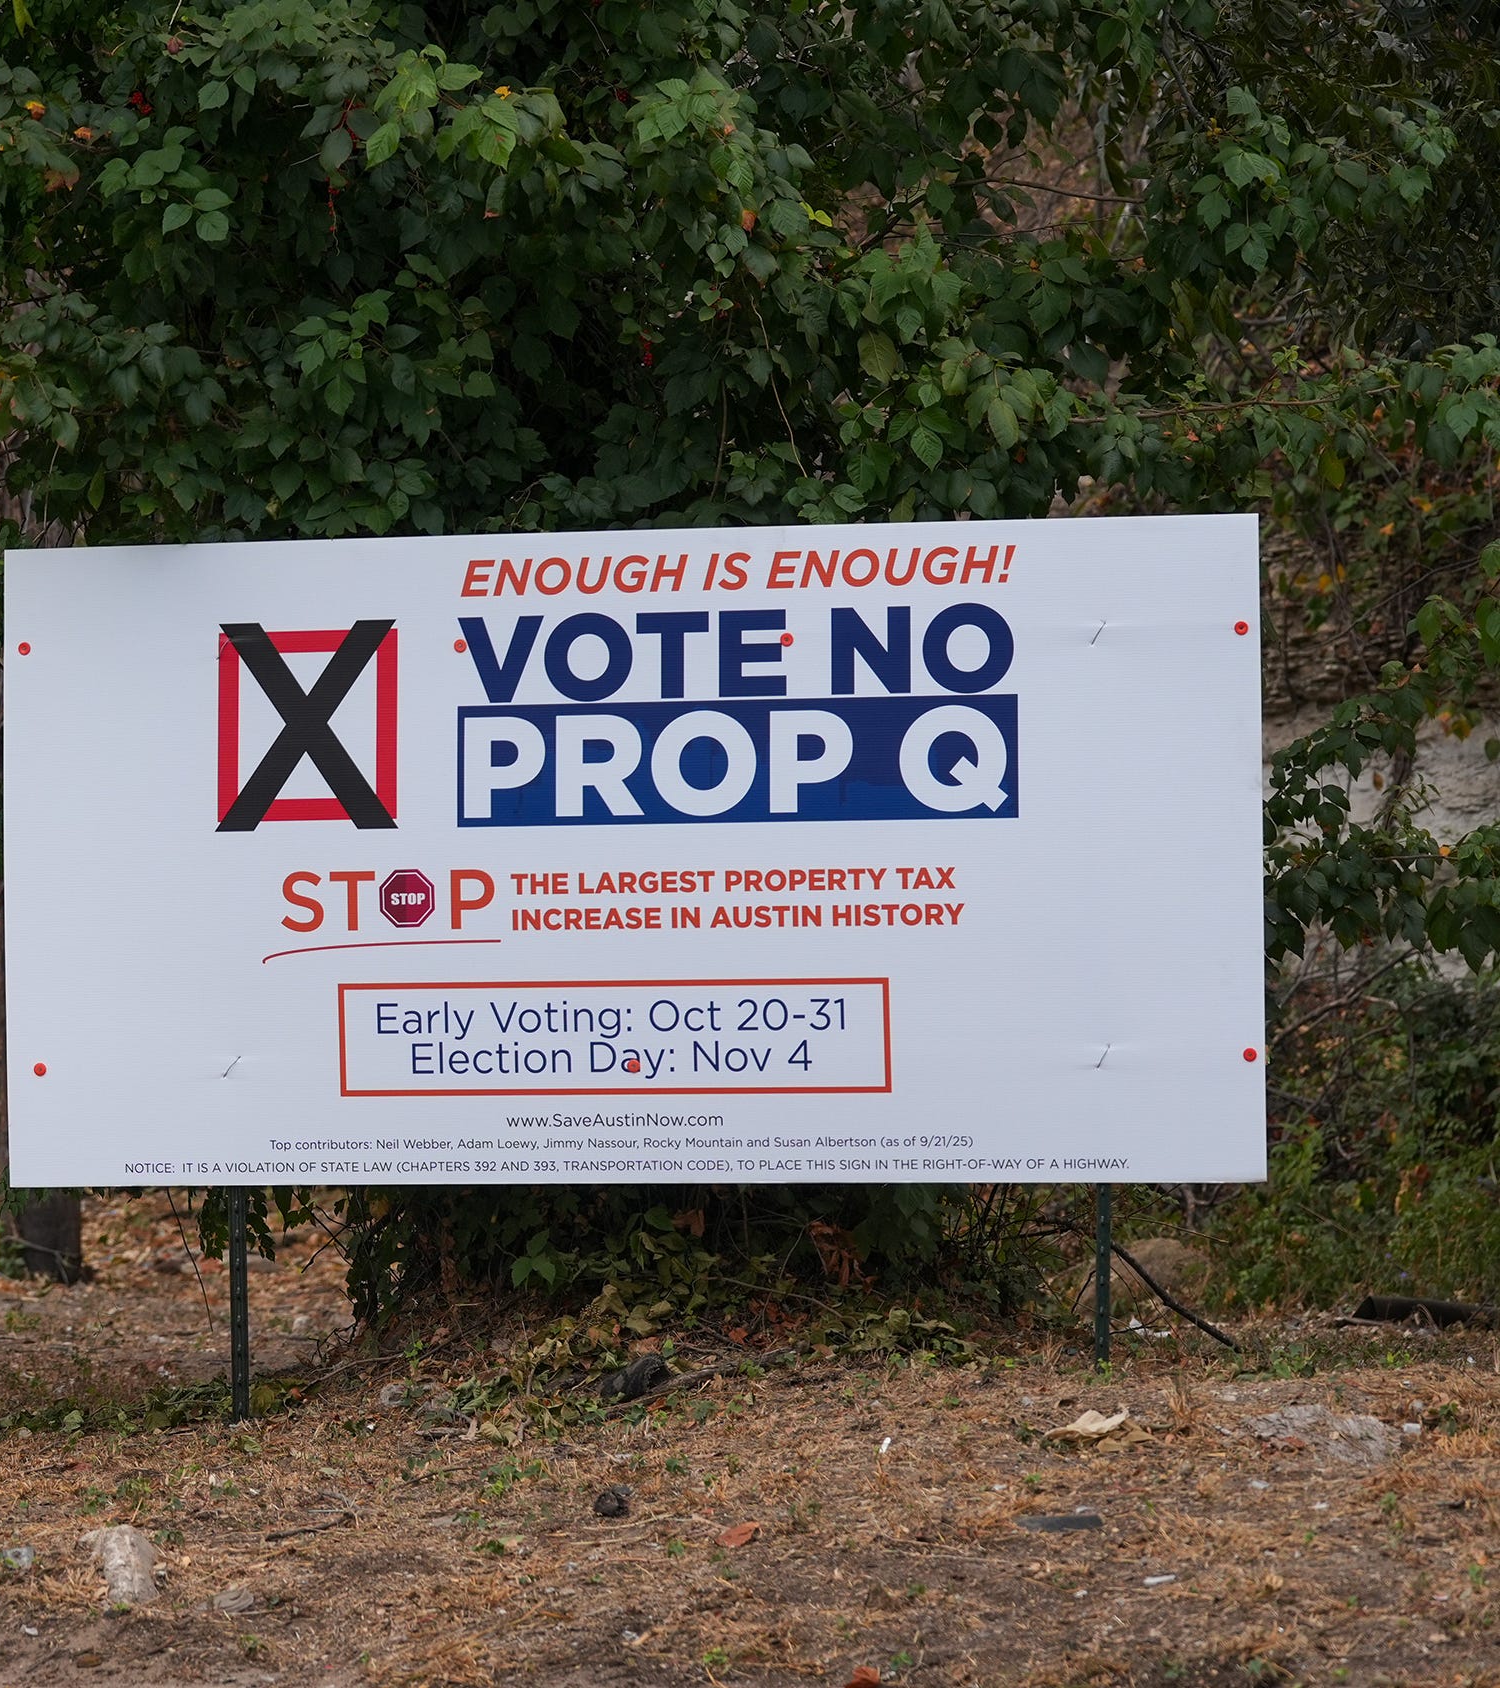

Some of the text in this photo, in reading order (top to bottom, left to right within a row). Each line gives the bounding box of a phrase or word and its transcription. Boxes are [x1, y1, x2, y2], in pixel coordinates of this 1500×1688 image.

[461, 545, 1016, 597] ENOUGH IS ENOUGH!
[459, 603, 1015, 704] VOTE NO
[464, 705, 1008, 819] PROP Q
[511, 867, 955, 895] THE LARGEST PROPERTY TAX
[391, 892, 426, 906] STOP
[512, 903, 964, 930] INCREASE IN AUSTIN HISTORY
[377, 998, 844, 1040] Early Voting: Oct 20-31
[412, 1039, 812, 1079] Election Day: Nov 4
[507, 1112, 724, 1128] www.SaveAustinNow.com
[270, 1134, 974, 1152] Top contributors: Neil Webber, Adam Loewy, Jimmy Nassour, Rocky Mountain and Susan Albertson (as of 9/21/25)
[125, 1158, 1130, 1174] NOTICE: IT IS A VIOLATION OF STATE LAW (CHAPTERS 392 AND 393, TRANSPORTATION CODE), TO PLACE THIS SIGN IN THE RIGHT-OF-WAY OF A HIGHWAY.
